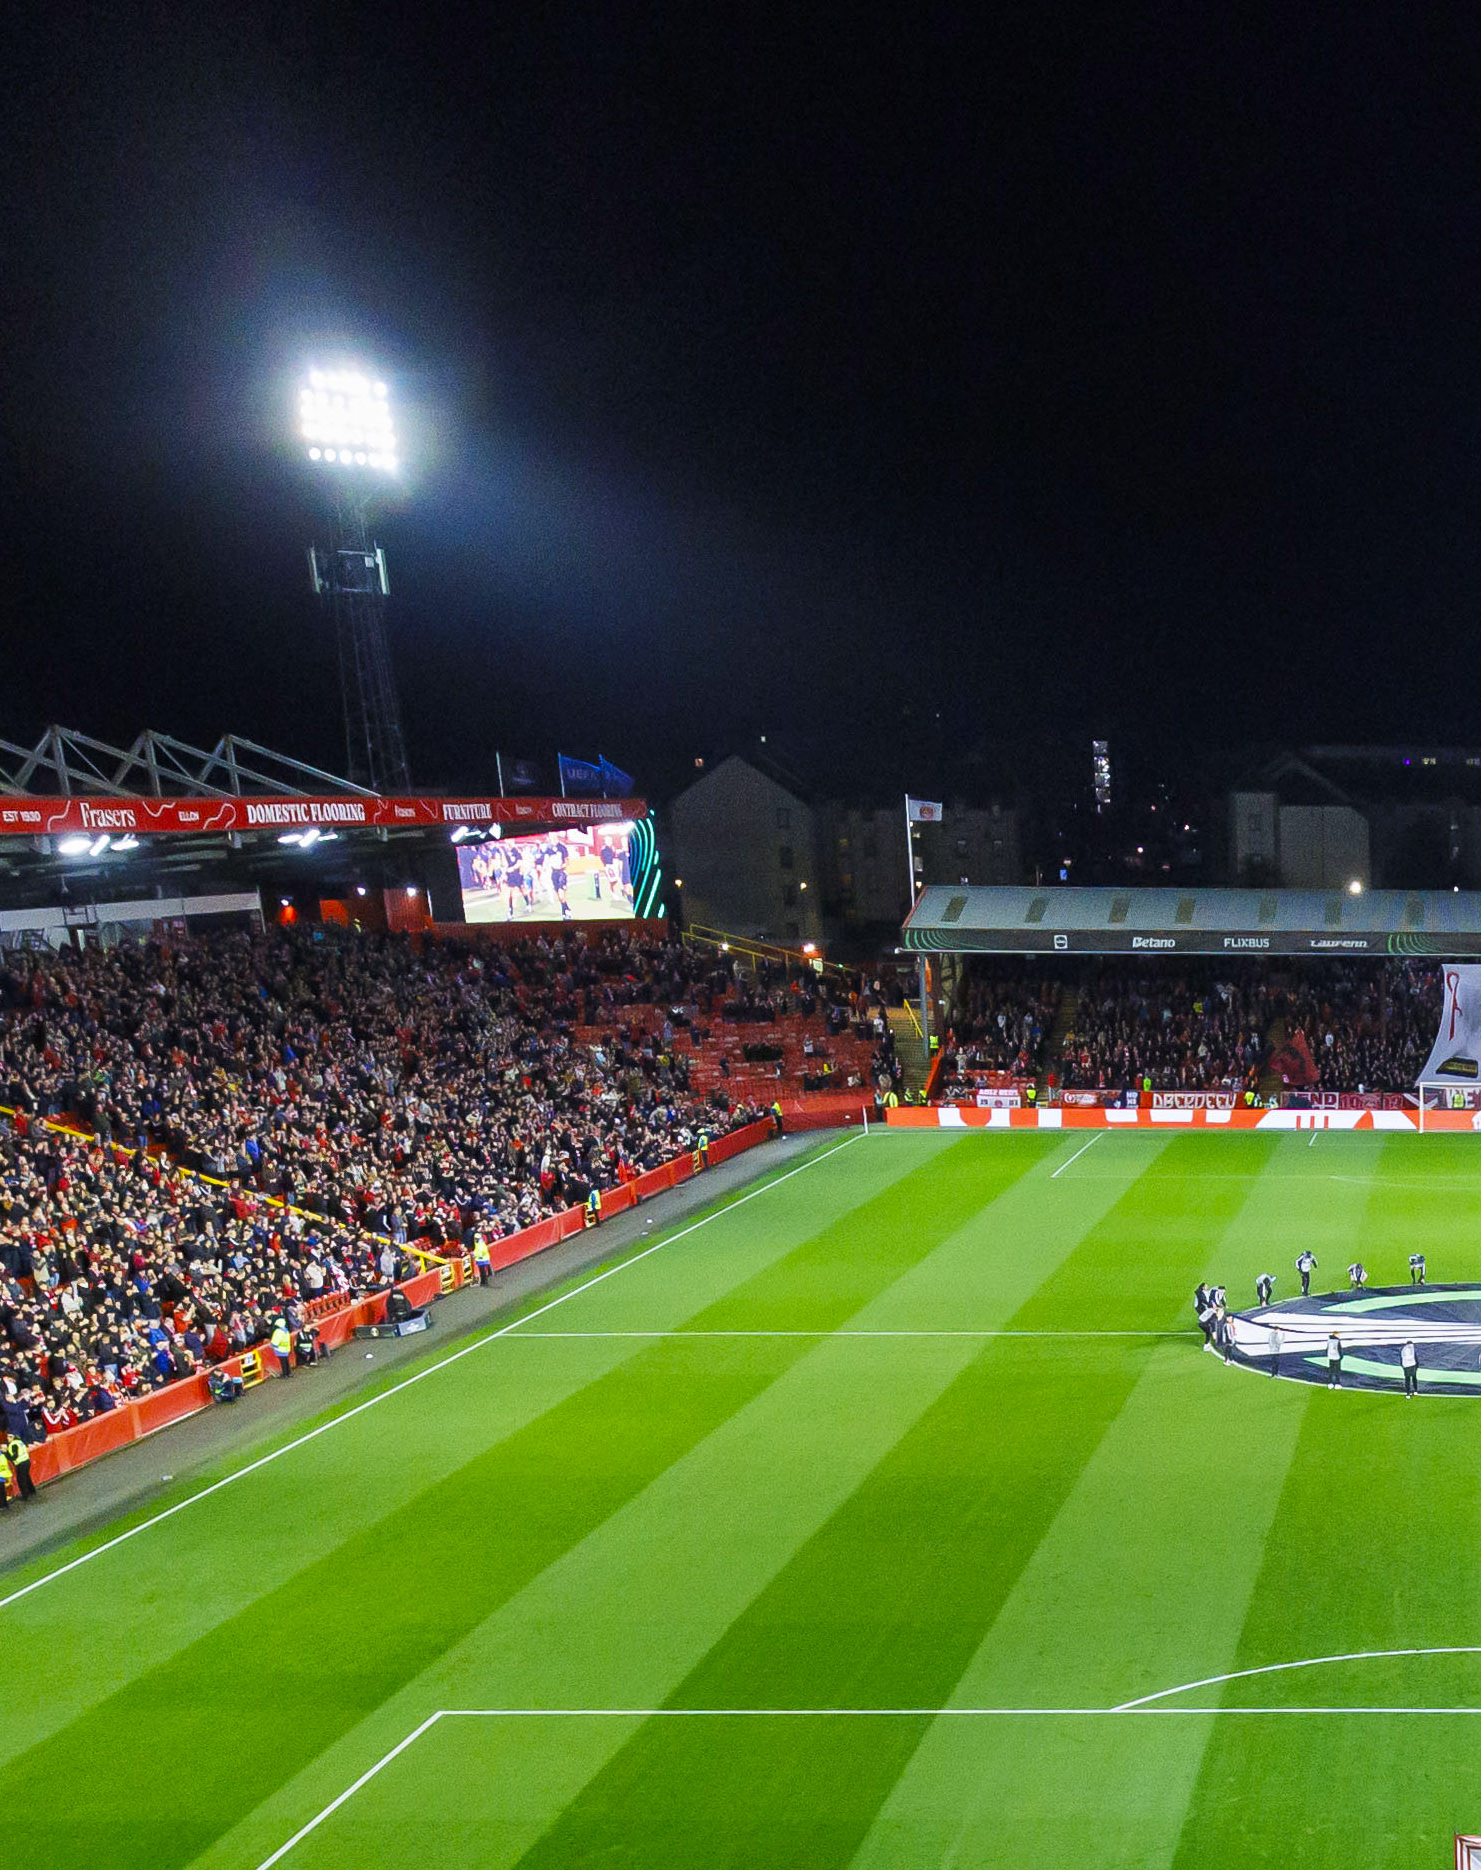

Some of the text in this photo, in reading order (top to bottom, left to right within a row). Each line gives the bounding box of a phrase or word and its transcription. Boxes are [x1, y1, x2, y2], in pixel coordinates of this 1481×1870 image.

[80, 802, 136, 828] Frasers
[246, 803, 366, 824] DOMESTIC FLOORING
[442, 803, 493, 820] FURNITURE
[551, 803, 589, 818] CONTRACT
[1132, 936, 1176, 949] Betano
[1224, 937, 1270, 949] FLIXBUS
